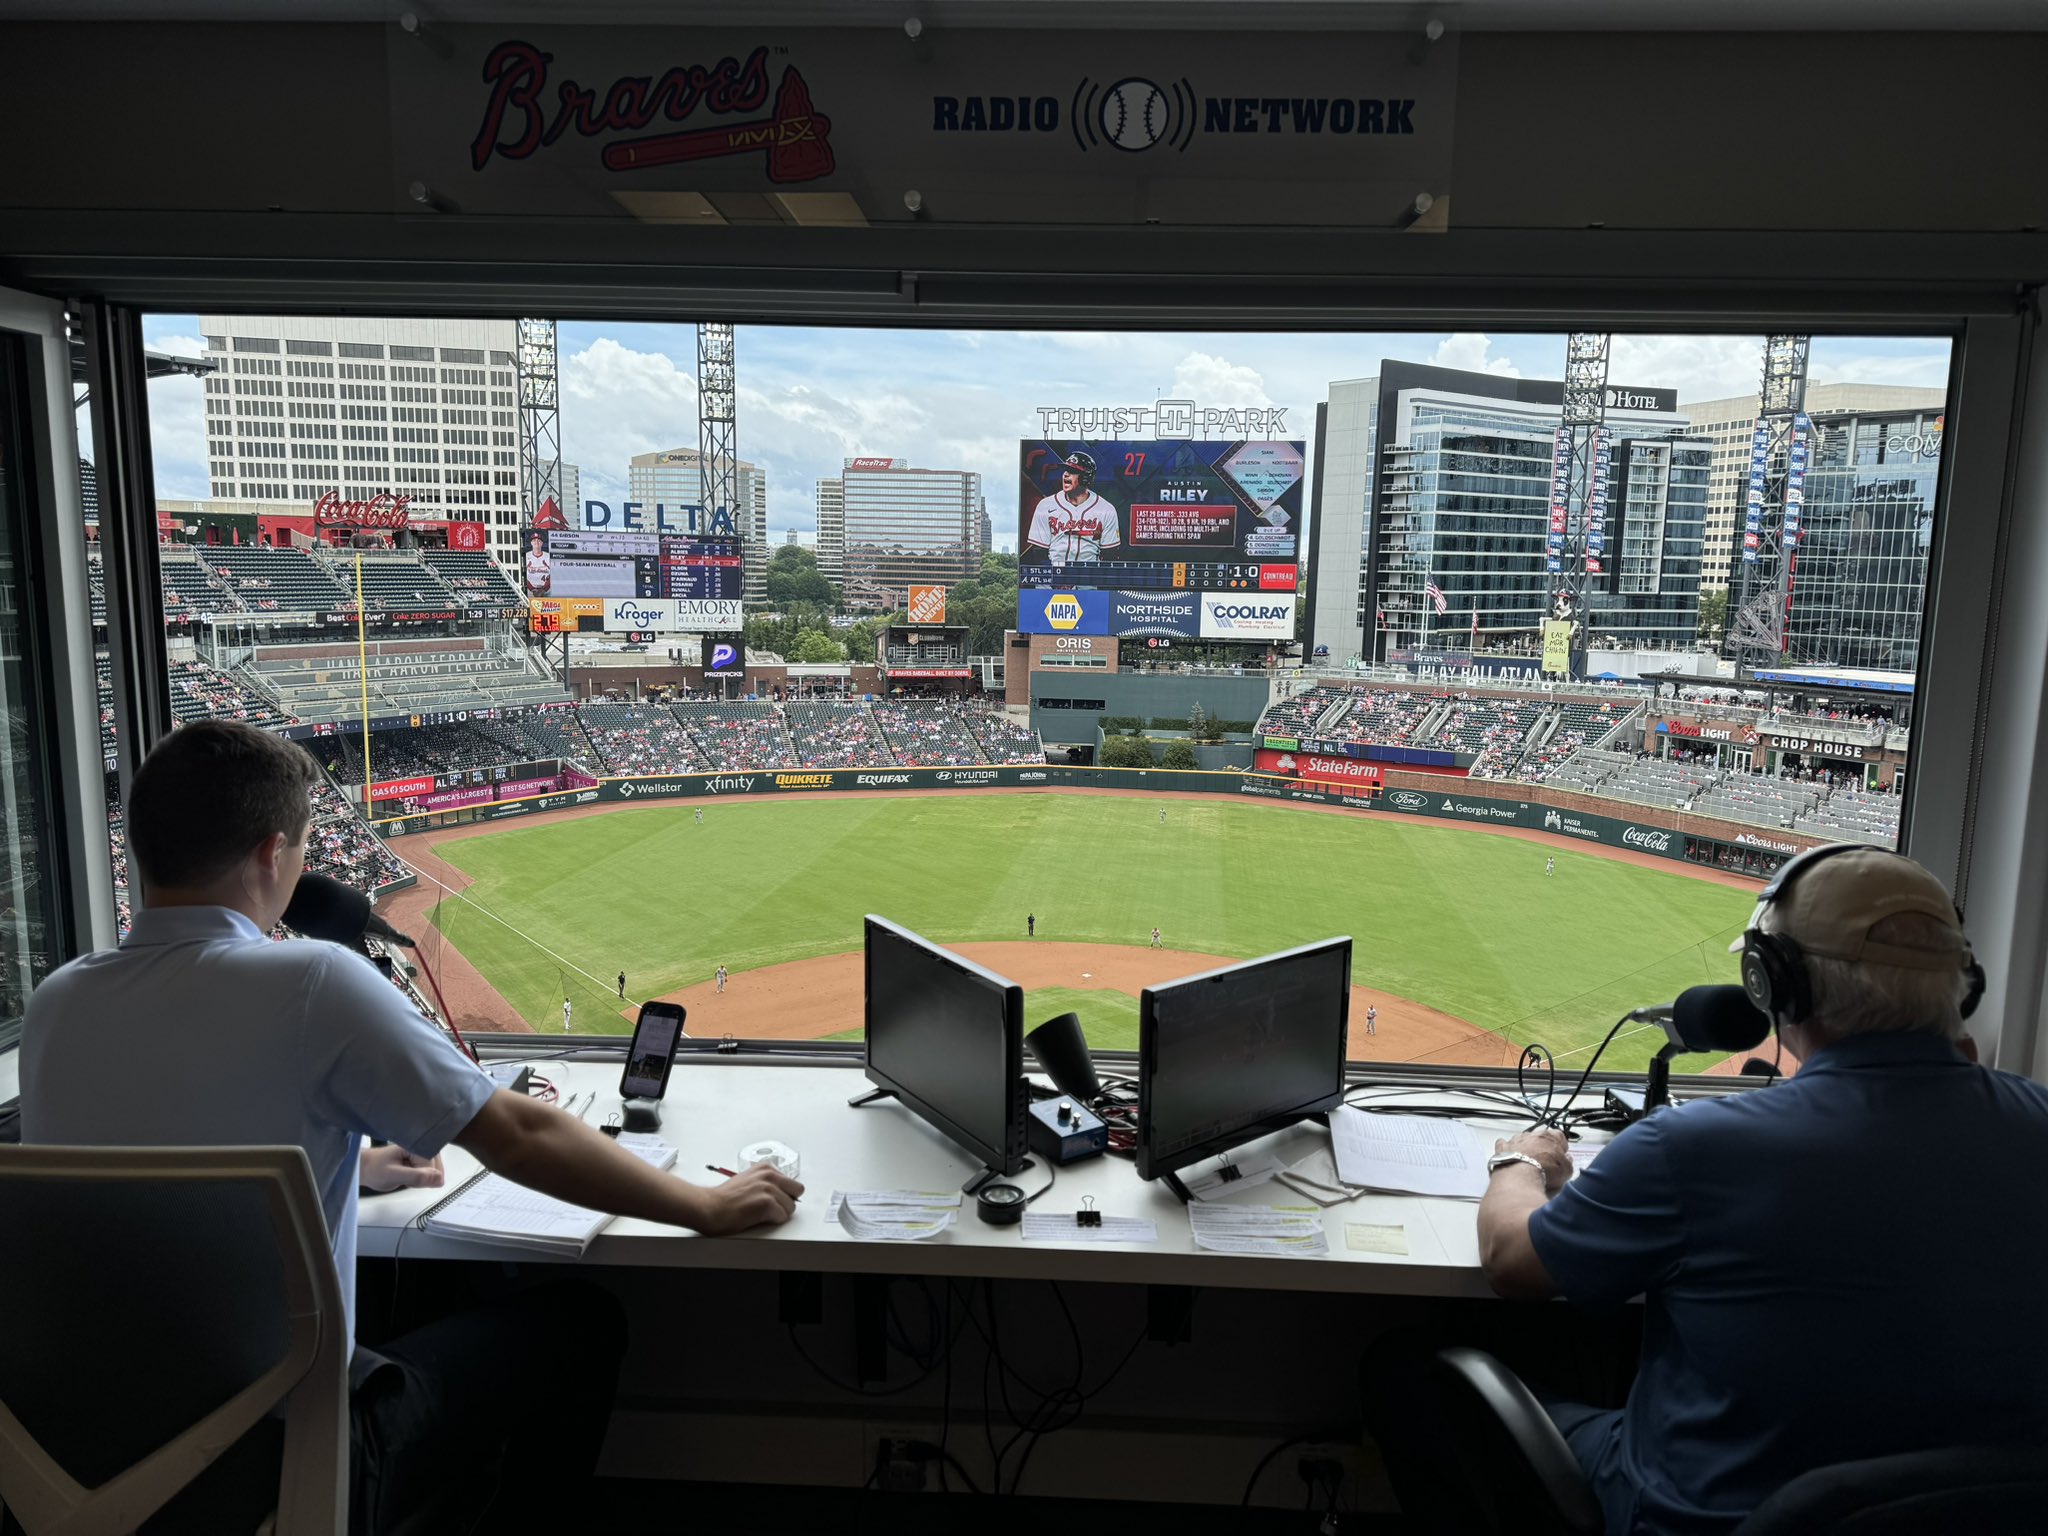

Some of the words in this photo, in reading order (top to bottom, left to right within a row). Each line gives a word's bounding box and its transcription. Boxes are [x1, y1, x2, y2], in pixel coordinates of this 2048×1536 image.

[471, 40, 769, 171] Braves
[933, 96, 1059, 132] RADIO
[1205, 96, 1414, 134] NETWORK
[1617, 390, 1659, 410] HOTEL
[1036, 407, 1149, 433] TRUIST
[1203, 407, 1288, 433] PARK
[855, 459, 889, 467] RaceTrac
[1124, 452, 1146, 476] 27
[1160, 489, 1209, 502] RILEY
[314, 489, 414, 529] Coca-Cola
[585, 500, 735, 533] DELTA
[1233, 566, 1242, 578] 1
[1248, 566, 1258, 578] 0
[914, 589, 928, 604] THE
[678, 600, 739, 615] EMORY
[909, 586, 944, 622] HOME
[1116, 605, 1193, 616] NORTHSIDE
[200, 612, 214, 624] 42
[327, 614, 346, 622] Best
[364, 613, 386, 621] Ever?
[392, 612, 409, 620] Coke
[410, 612, 430, 620] ZERO
[468, 610, 483, 618] 1:29
[614, 601, 664, 629] Kroger
[923, 601, 944, 622] DEPOT
[1050, 604, 1077, 620] NAPA
[1213, 605, 1290, 620] COOLRAY
[533, 614, 559, 626] 279
[1130, 615, 1178, 624] HOSPITAL
[641, 632, 653, 641] LG
[1056, 637, 1092, 649] ORIS
[1159, 639, 1170, 647] LG
[1413, 652, 1443, 664] Braves
[448, 712, 454, 722] 1
[458, 711, 467, 721] 0
[1668, 720, 1701, 737] Coors
[1700, 727, 1731, 741] LIGHT
[1324, 743, 1335, 752] NL
[1771, 736, 1808, 749] CHOP
[1813, 741, 1863, 758] HOUSE
[776, 774, 832, 785] QUIKRETE
[856, 774, 911, 785] EQUIFAX
[954, 770, 998, 779] HYUNDAI
[371, 787, 390, 797] GAS
[397, 782, 426, 794] SOUTH
[436, 778, 447, 788] AL
[637, 783, 682, 794] Wellstar
[705, 776, 755, 794] xfinity
[427, 793, 461, 805] AMERICA'S
[460, 789, 487, 801] LARGEST
[488, 788, 493, 796] &
[527, 779, 555, 789] NETWORK
[1241, 784, 1281, 797] globalpayments
[1395, 792, 1421, 806] Ford
[1456, 804, 1488, 817] Georgia
[1490, 808, 1517, 819] Power
[1564, 818, 1581, 827] KAISER
[1563, 826, 1598, 838] PERMANENTE
[1622, 826, 1672, 852] Coca-Cola
[1746, 834, 1771, 848] Coors
[1773, 842, 1797, 853] LIGHT
